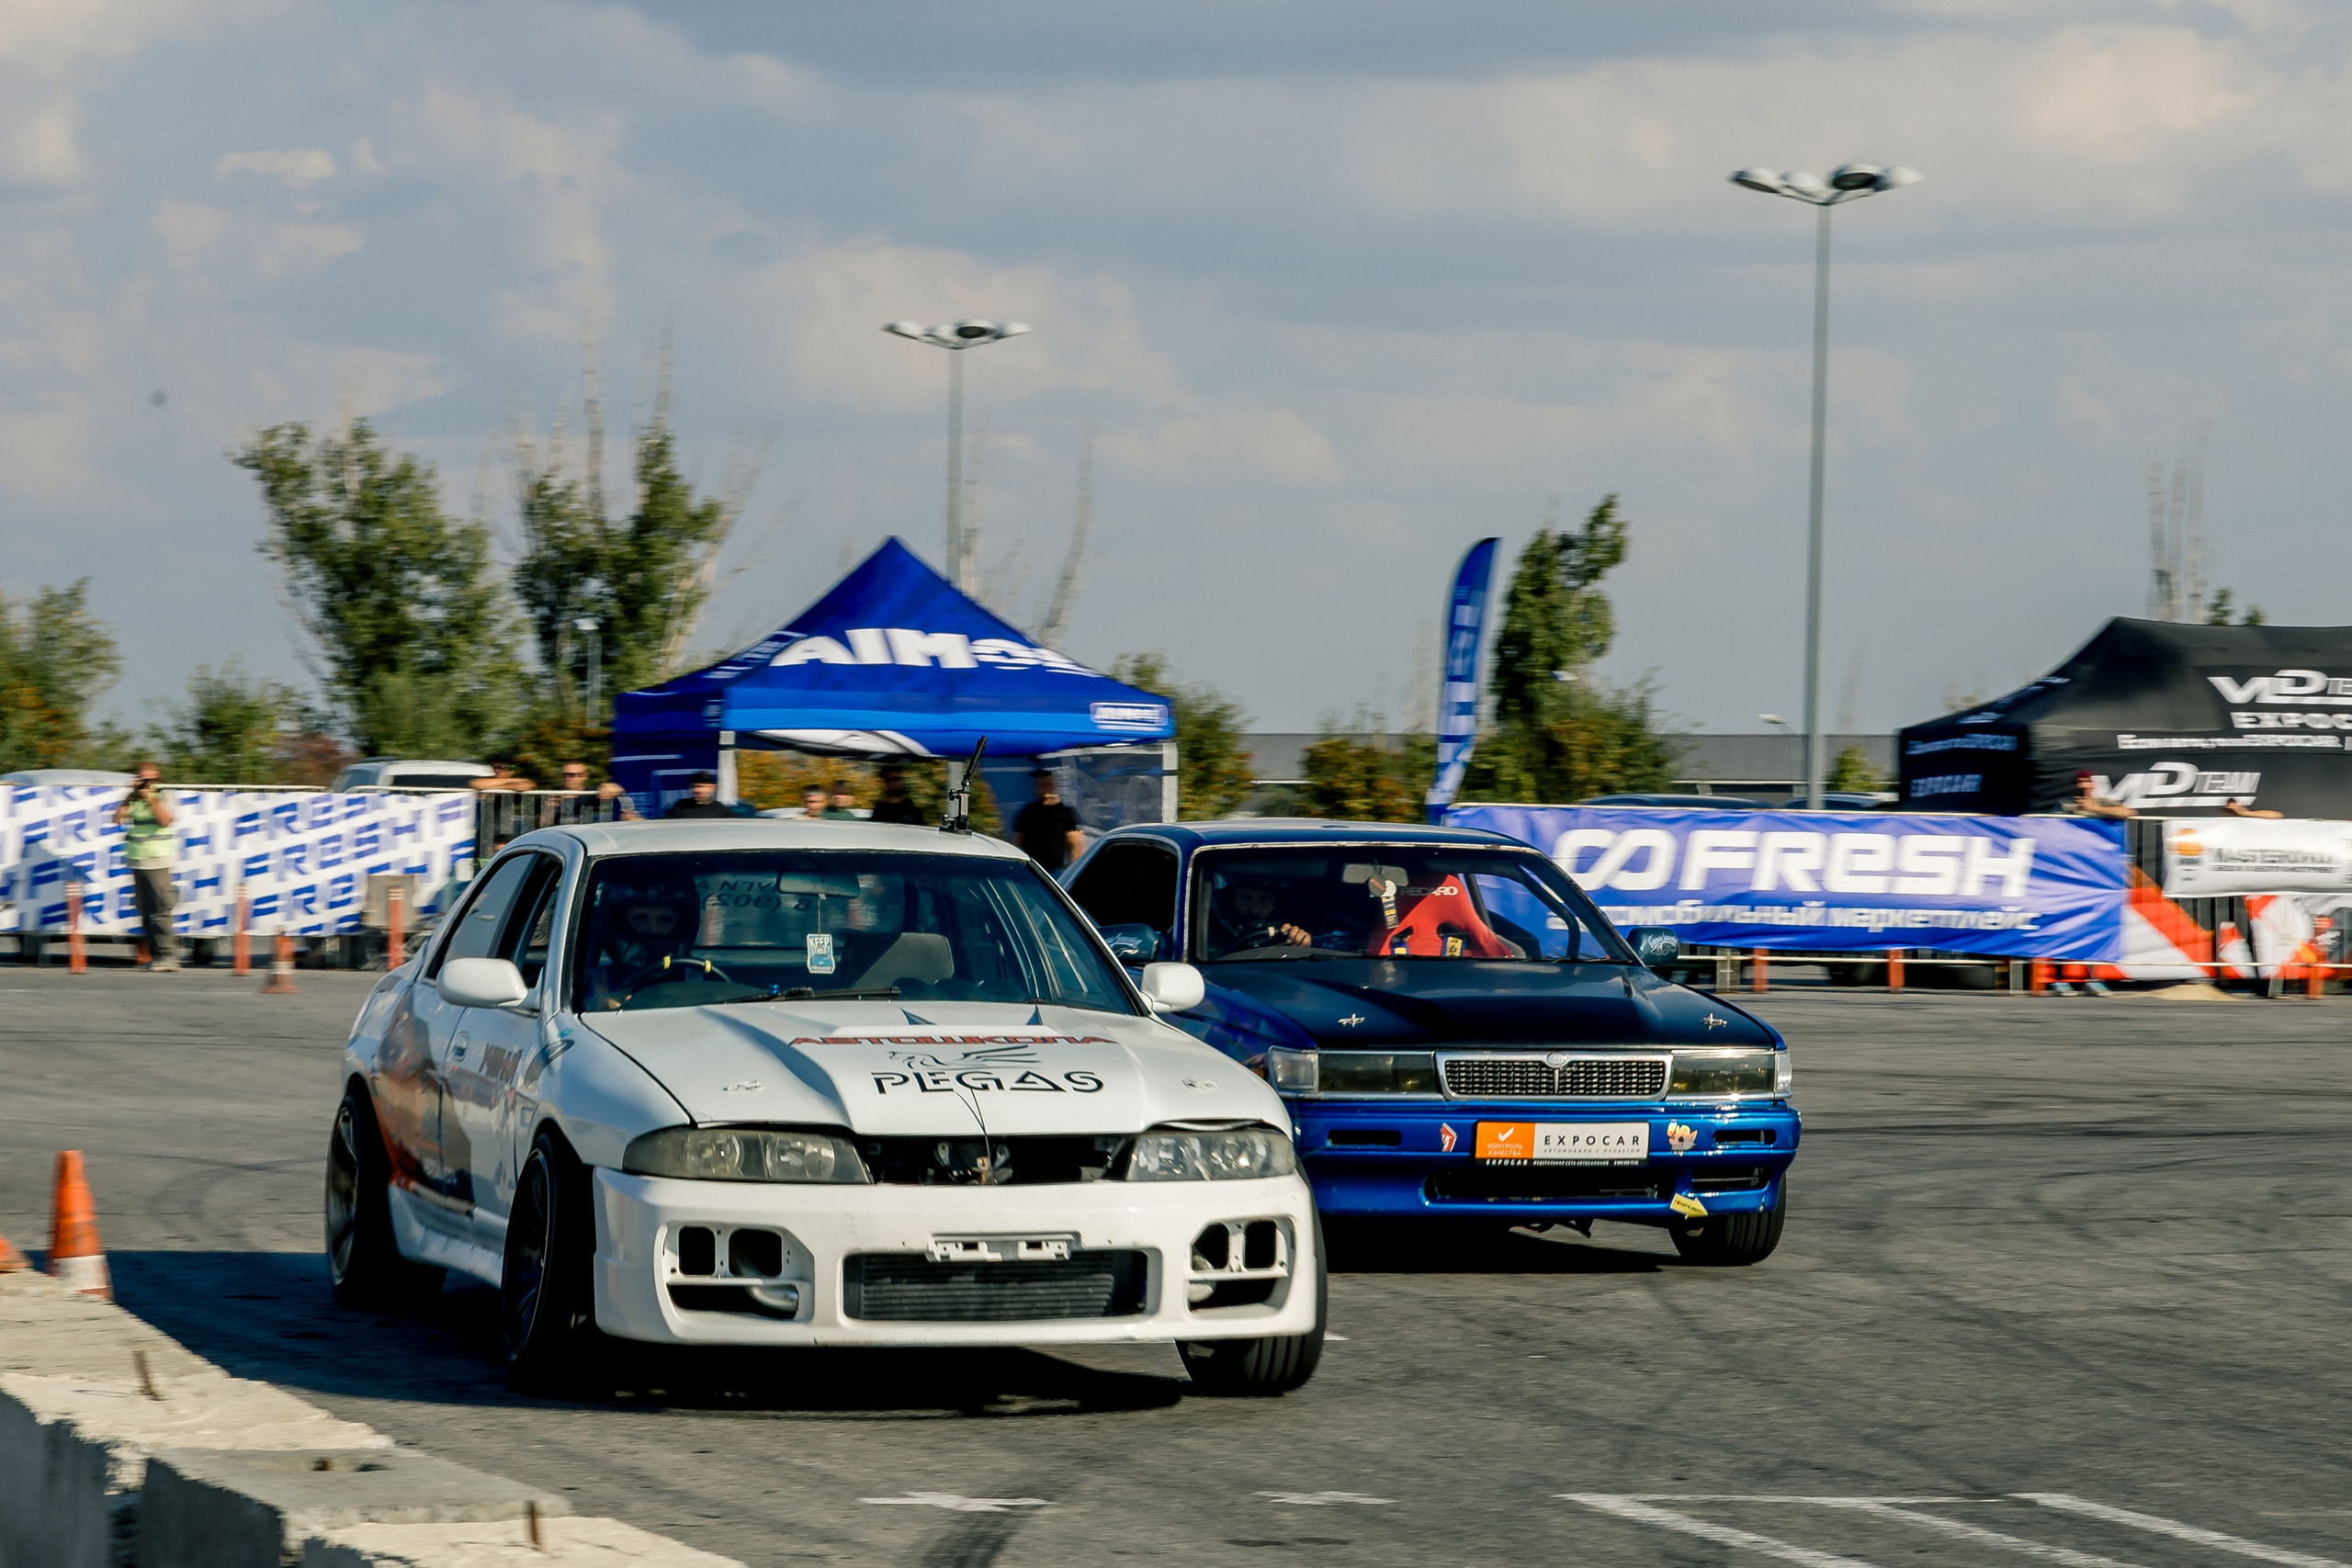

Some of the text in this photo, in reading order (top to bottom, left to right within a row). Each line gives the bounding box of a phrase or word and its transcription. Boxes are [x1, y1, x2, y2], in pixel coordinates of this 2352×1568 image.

[1400, 886, 1459, 897] RECARO
[870, 1070, 1104, 1095] PEGAS
[1544, 1135, 1640, 1146] EXPOCAR
[1486, 1158, 1529, 1167] EXPOCAR
